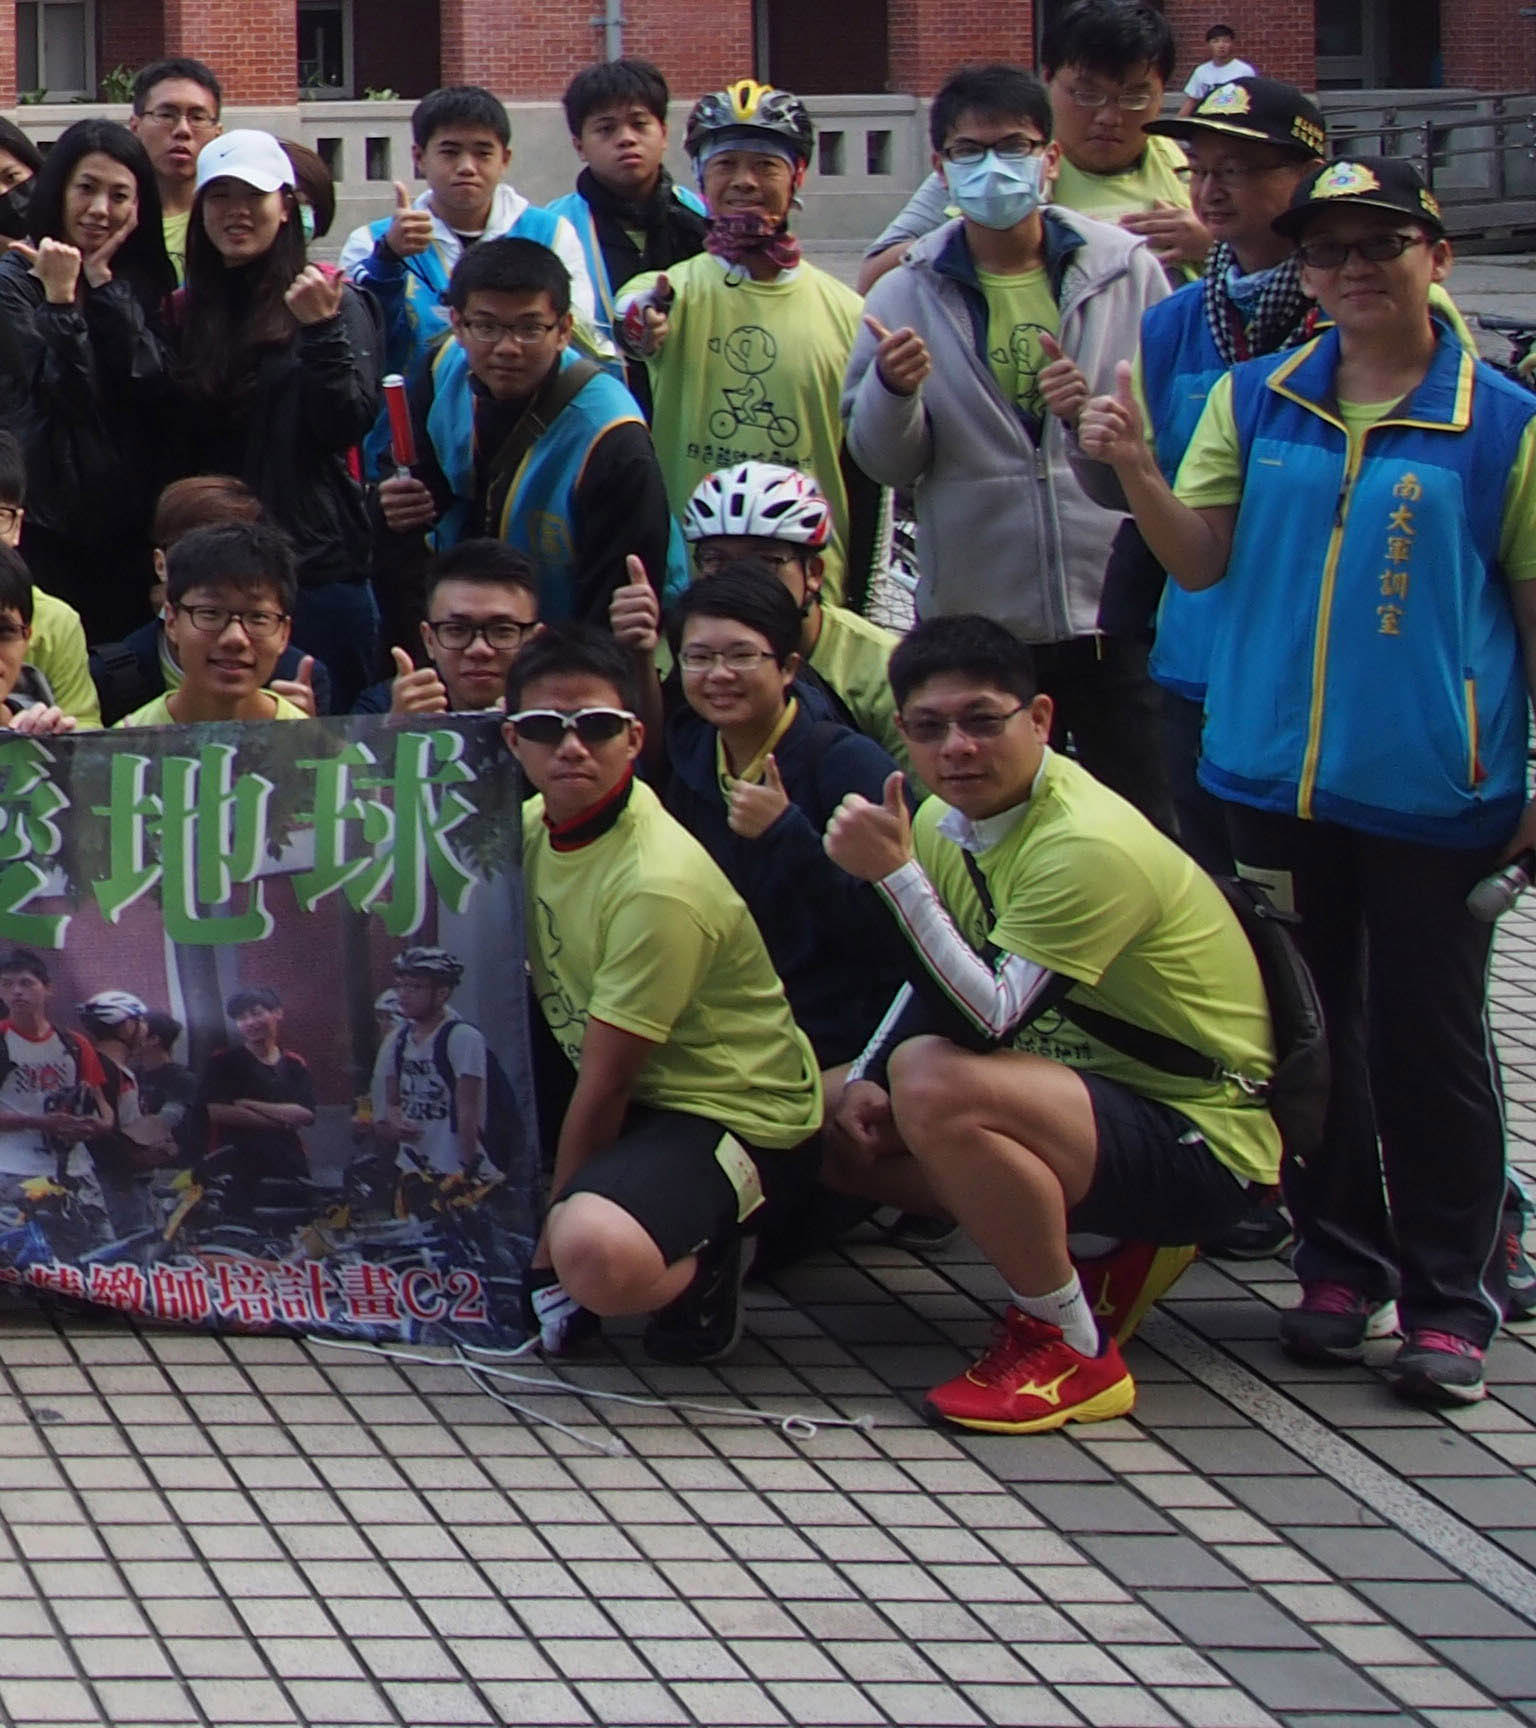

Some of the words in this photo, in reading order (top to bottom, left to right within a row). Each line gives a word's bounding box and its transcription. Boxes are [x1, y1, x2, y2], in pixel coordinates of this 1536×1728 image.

[1376, 471, 1423, 636] 南大軍訓室
